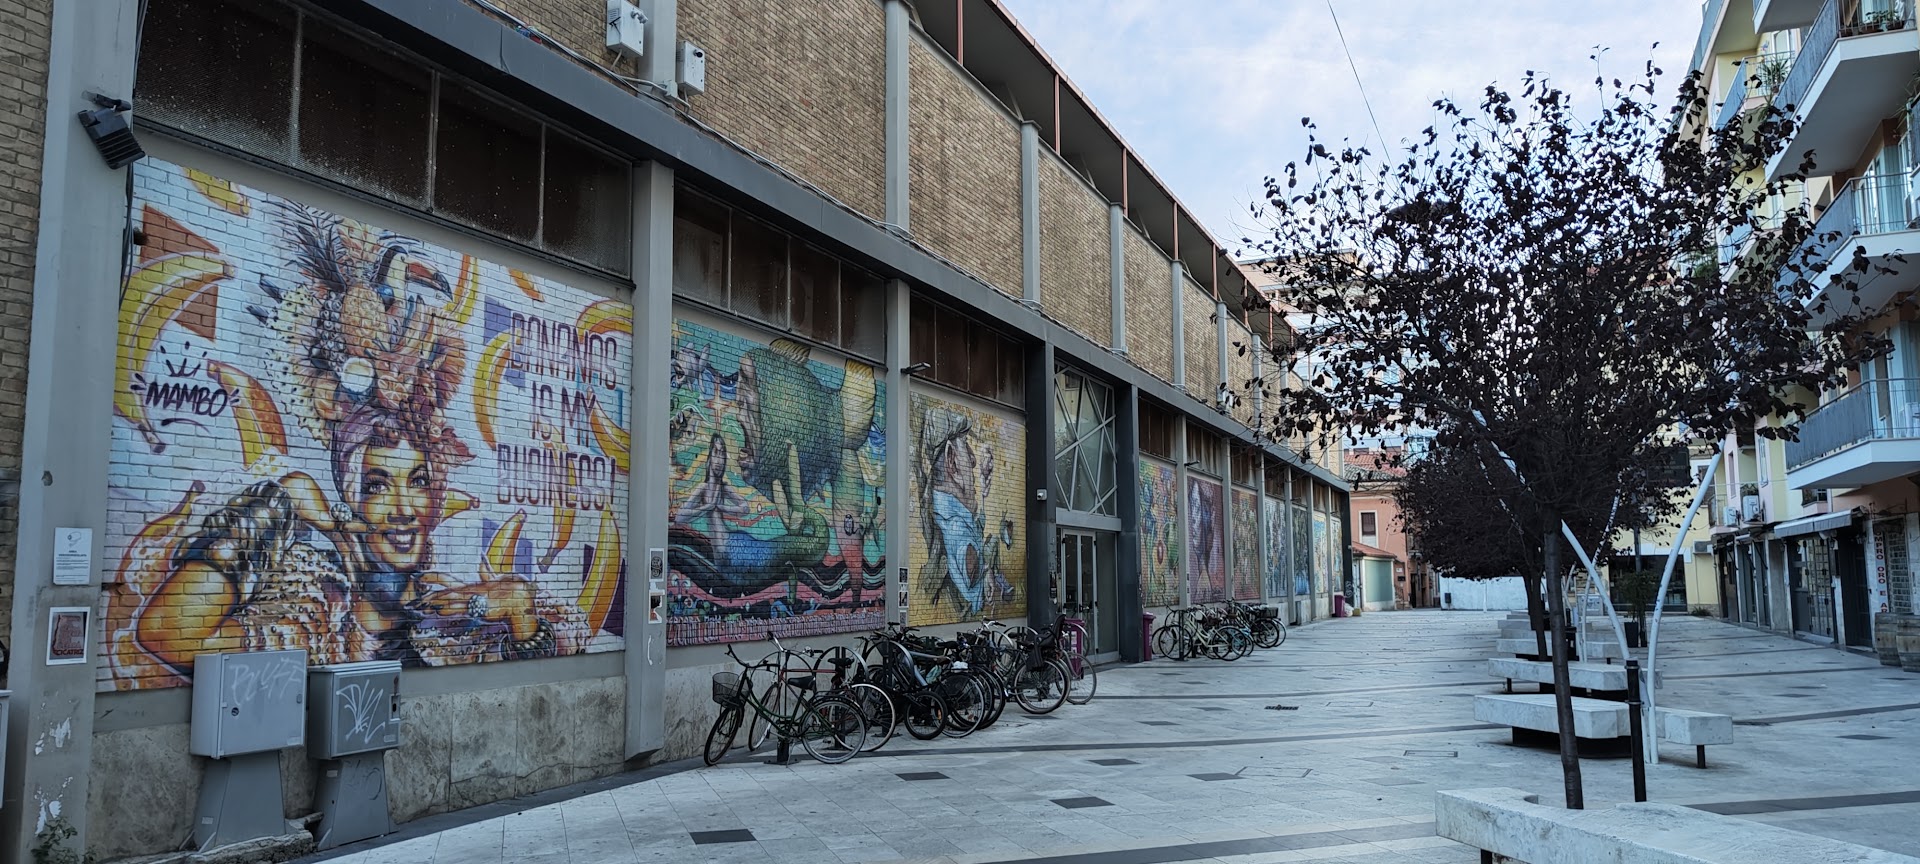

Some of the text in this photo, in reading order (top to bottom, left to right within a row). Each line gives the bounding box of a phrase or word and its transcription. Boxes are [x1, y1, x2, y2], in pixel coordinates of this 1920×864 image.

[511, 312, 617, 390] BANANAS
[145, 381, 228, 417] MAMBO
[531, 381, 596, 448] IS MY
[497, 443, 616, 511] BUSINESS!
[1877, 566, 1885, 584] ORO
